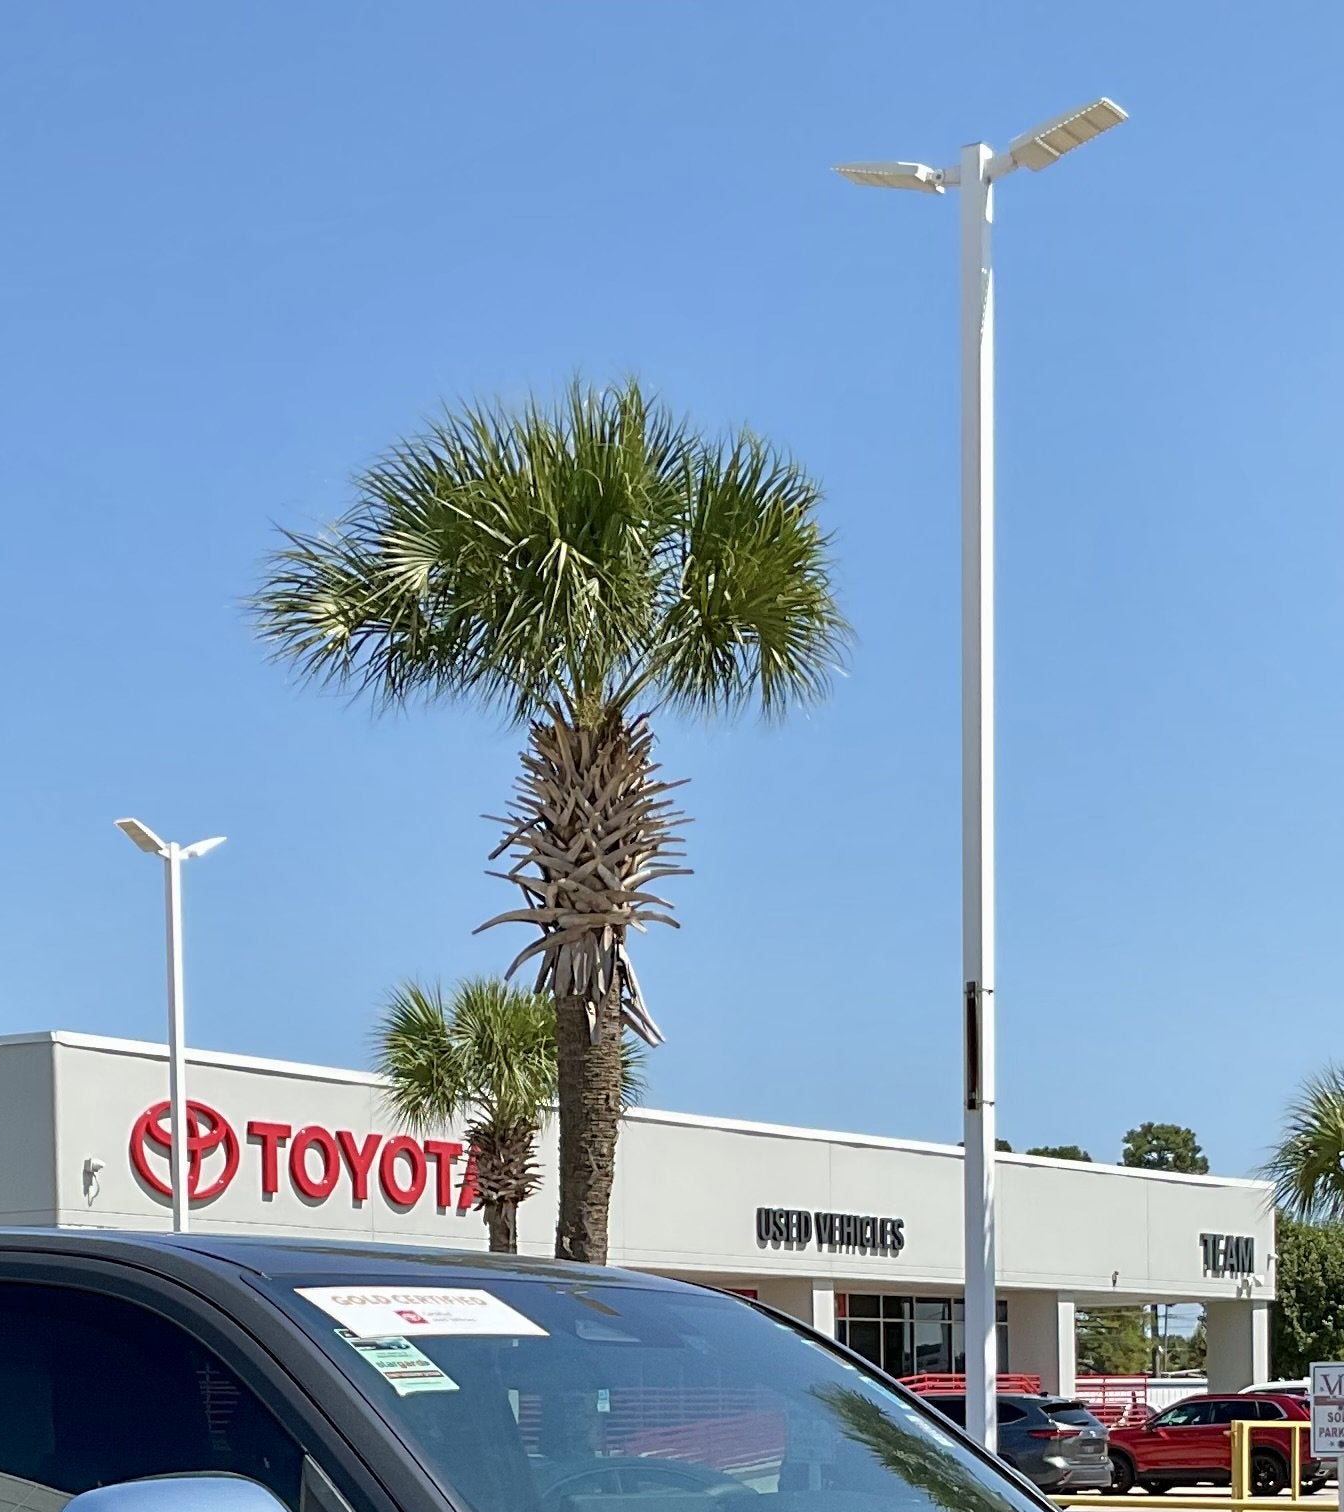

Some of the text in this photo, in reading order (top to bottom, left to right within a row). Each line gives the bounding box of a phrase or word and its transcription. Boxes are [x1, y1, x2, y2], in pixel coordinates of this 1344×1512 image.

[757, 1207, 905, 1250] USED VEHICLES
[1199, 1233, 1255, 1273] TEAM
[331, 1294, 488, 1306] GOLD CERTIFIED
